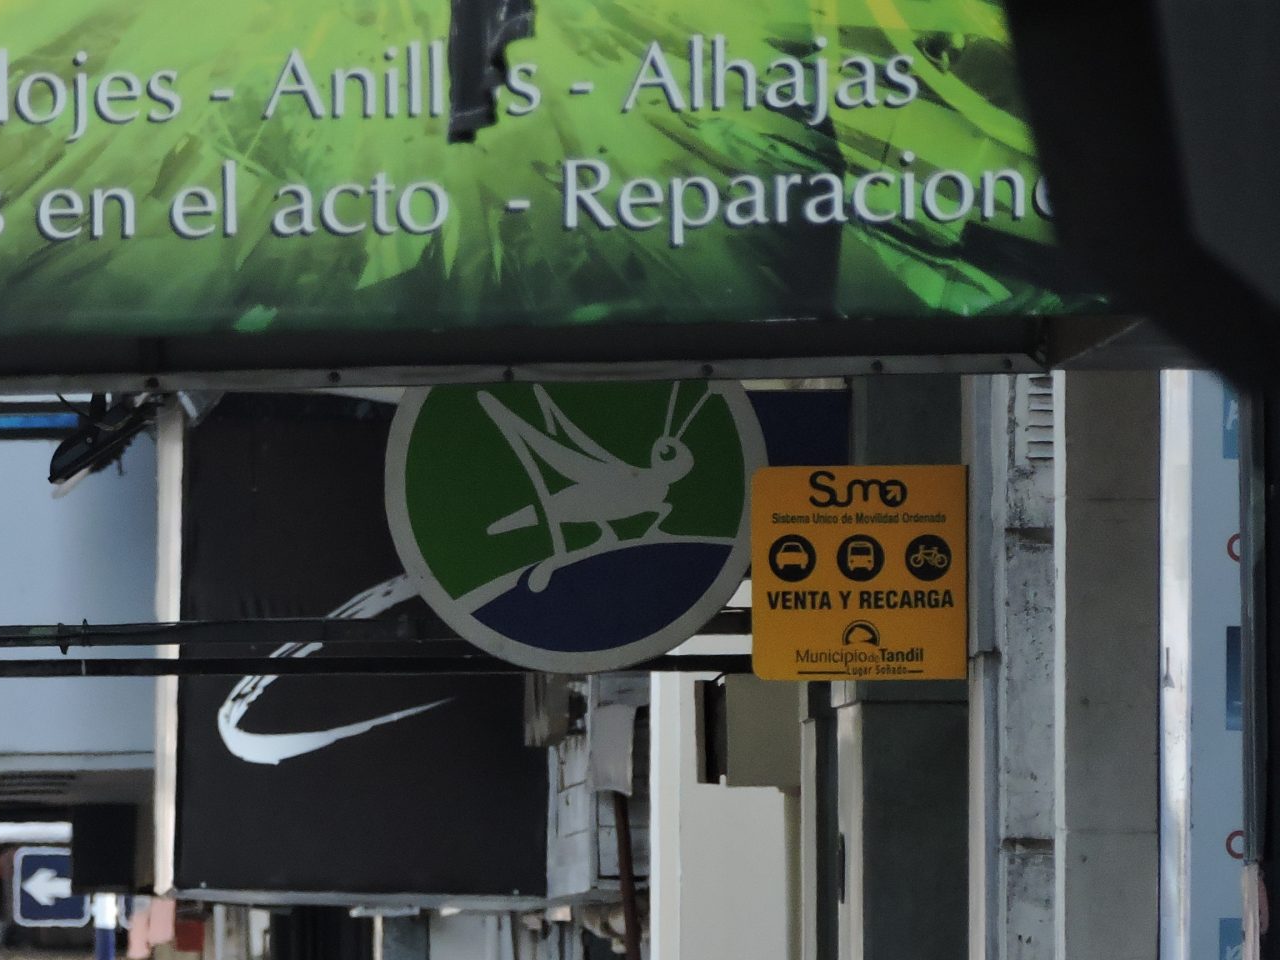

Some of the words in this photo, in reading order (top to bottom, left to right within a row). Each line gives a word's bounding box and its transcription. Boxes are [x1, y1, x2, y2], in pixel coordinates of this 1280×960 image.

[262, 39, 541, 121] Anills
[622, 34, 920, 125] Alhajas
[36, 185, 136, 242] en
[170, 159, 237, 239] el
[271, 171, 451, 238] acto
[808, 470, 908, 508] Sumo
[771, 513, 810, 525] Sistema
[841, 513, 853, 524] de
[856, 513, 900, 524] Movilidad
[902, 512, 946, 524] Ordenado
[767, 591, 832, 610] VENTA
[839, 591, 853, 609] Y
[859, 589, 954, 609] RECARGA
[795, 648, 868, 667] Municipio
[879, 648, 924, 662] Tandil
[846, 665, 872, 677] Lugar
[875, 664, 908, 676] Soñado
